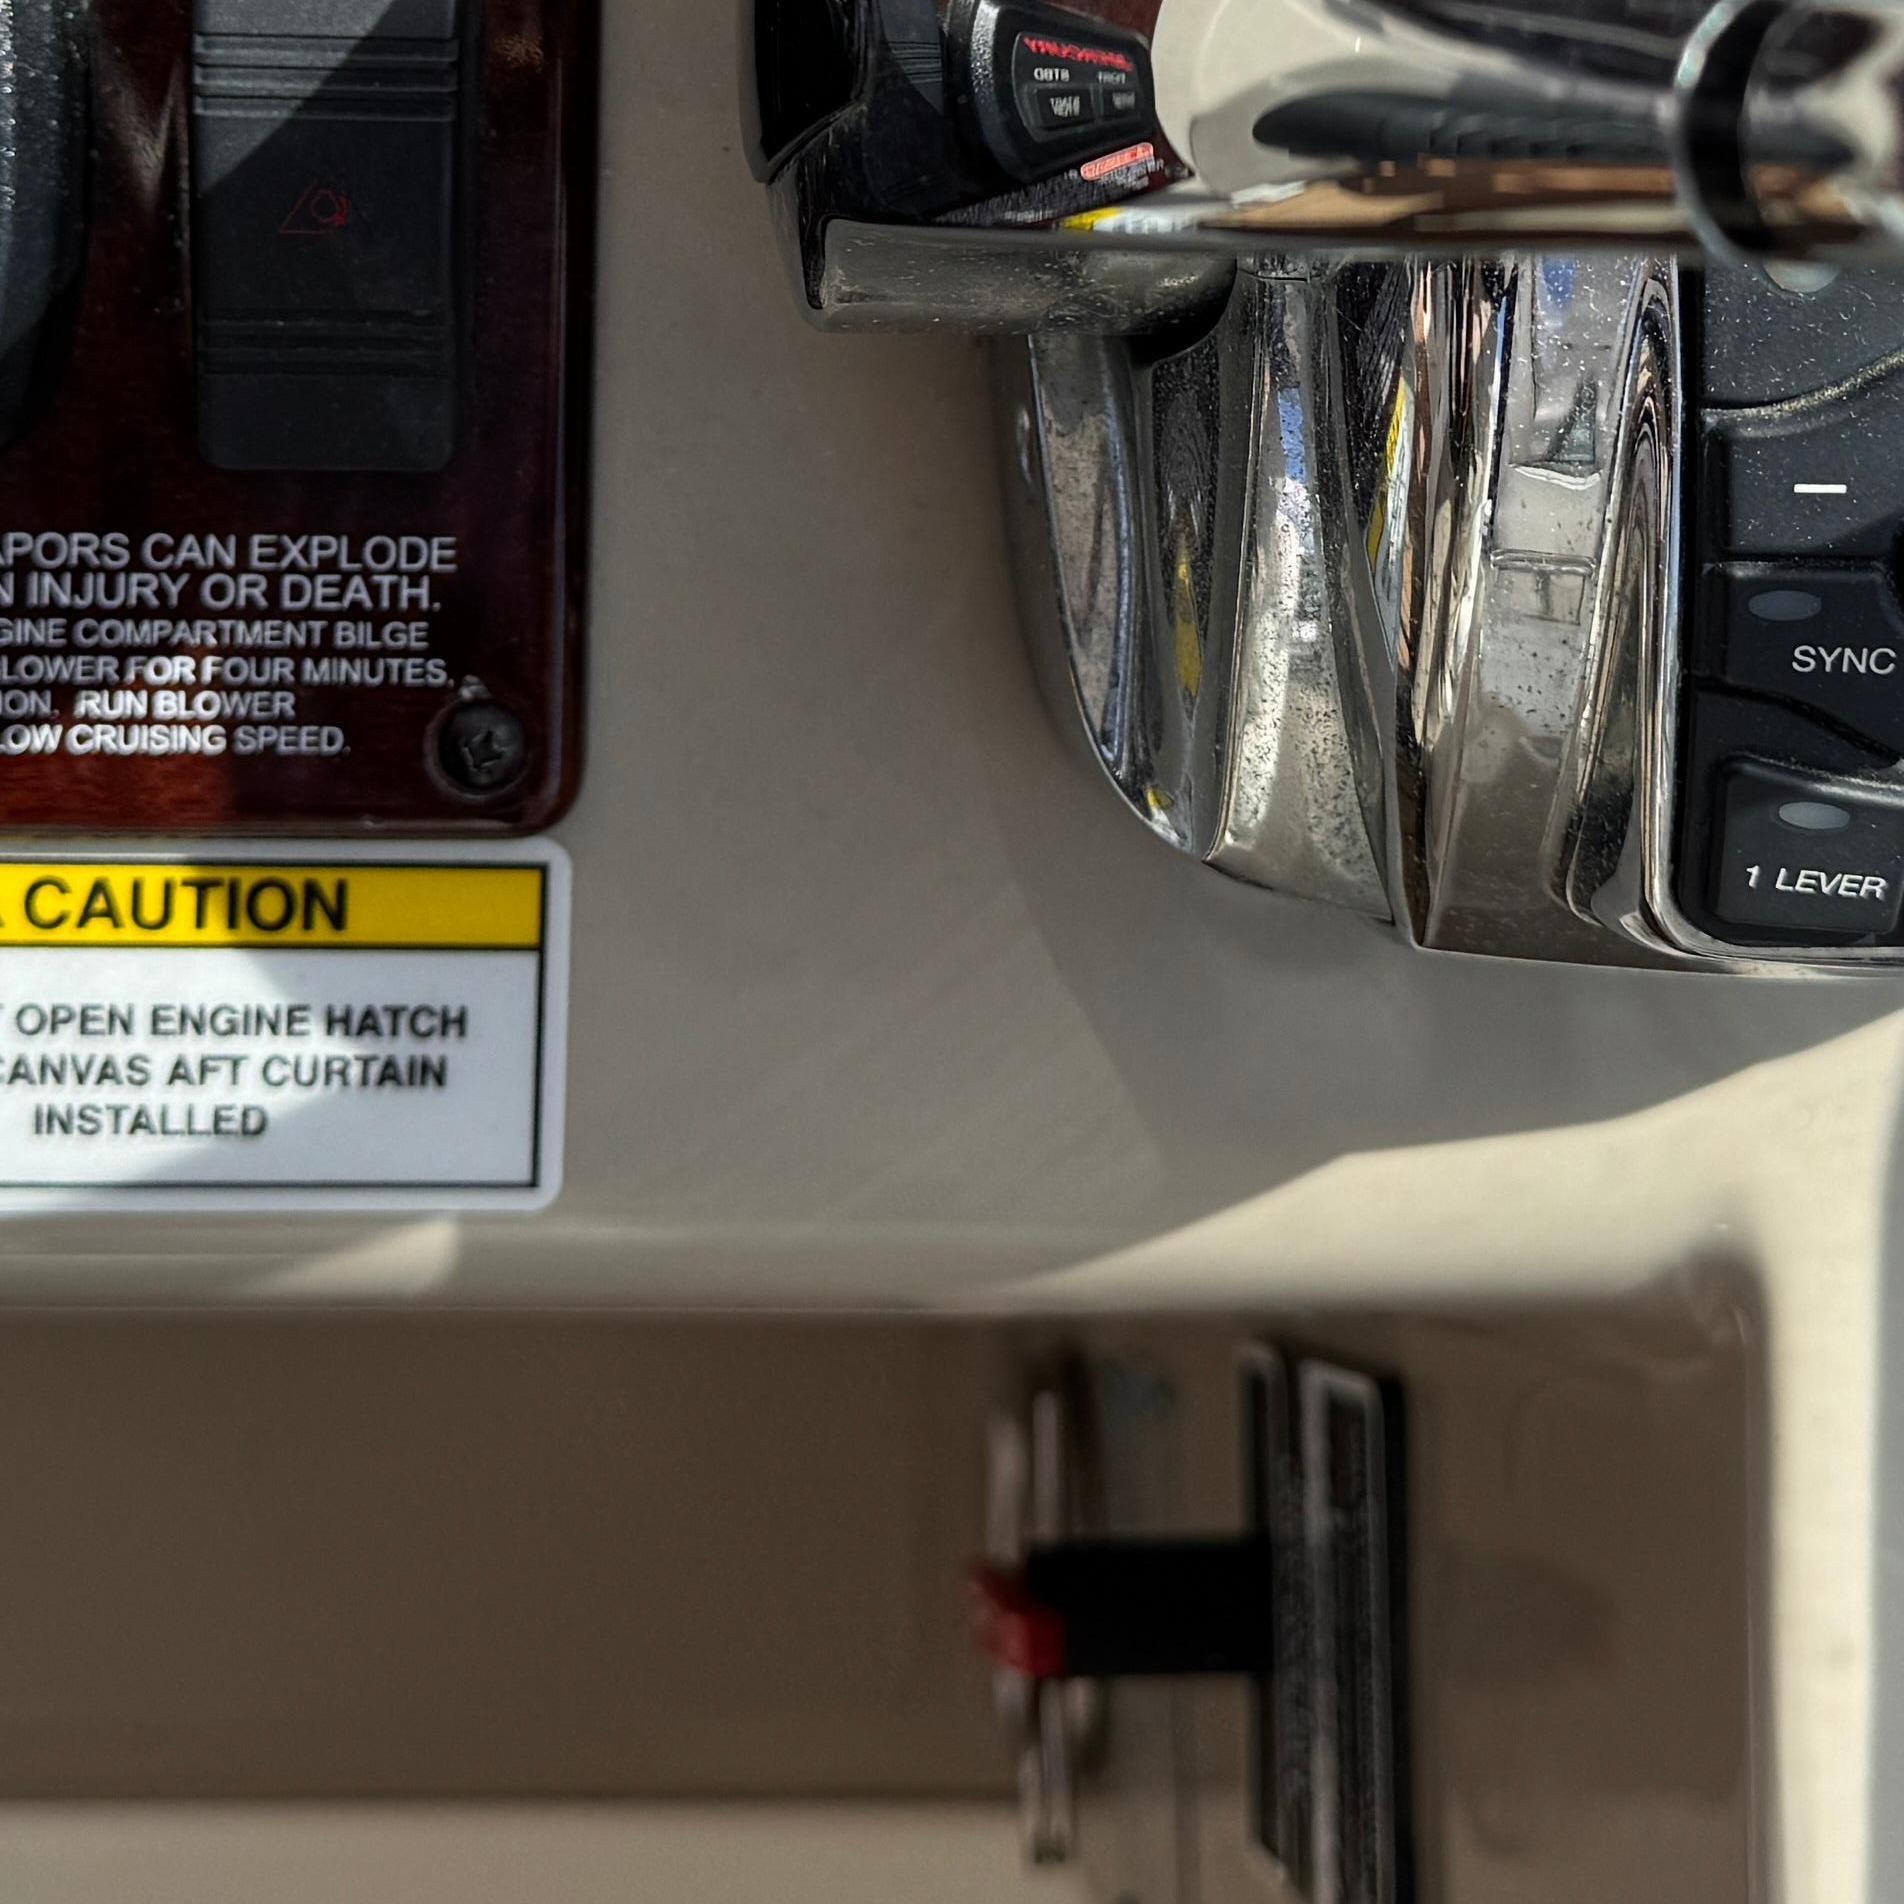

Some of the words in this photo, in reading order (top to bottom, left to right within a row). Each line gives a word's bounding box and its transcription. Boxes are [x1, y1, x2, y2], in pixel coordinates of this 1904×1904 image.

[142, 533, 235, 570] CAN
[249, 534, 457, 573] EXPLODE
[27, 572, 190, 609] INJURY
[201, 573, 267, 610] OR
[281, 574, 441, 612] DEATH.
[72, 618, 327, 648] COMPARTMENT
[333, 620, 429, 649] BILGE
[125, 655, 194, 685] FOR
[199, 656, 293, 686] FOUR
[1791, 645, 1897, 677] SYNC
[73, 688, 148, 719] RUN
[151, 689, 295, 719] BLOWER
[65, 724, 226, 755] CRUISING
[232, 725, 351, 757] SPEED.
[1745, 865, 1761, 888] 1
[1775, 868, 1888, 899] LEVER
[24, 877, 350, 934] CAUTION
[15, 1003, 135, 1037] OPEN
[150, 1004, 310, 1038] ENGINE
[323, 1004, 469, 1039] HATCH
[166, 1054, 242, 1088] AFT
[261, 1055, 448, 1089] CURTAIN
[31, 1104, 268, 1138] INSTALLED
